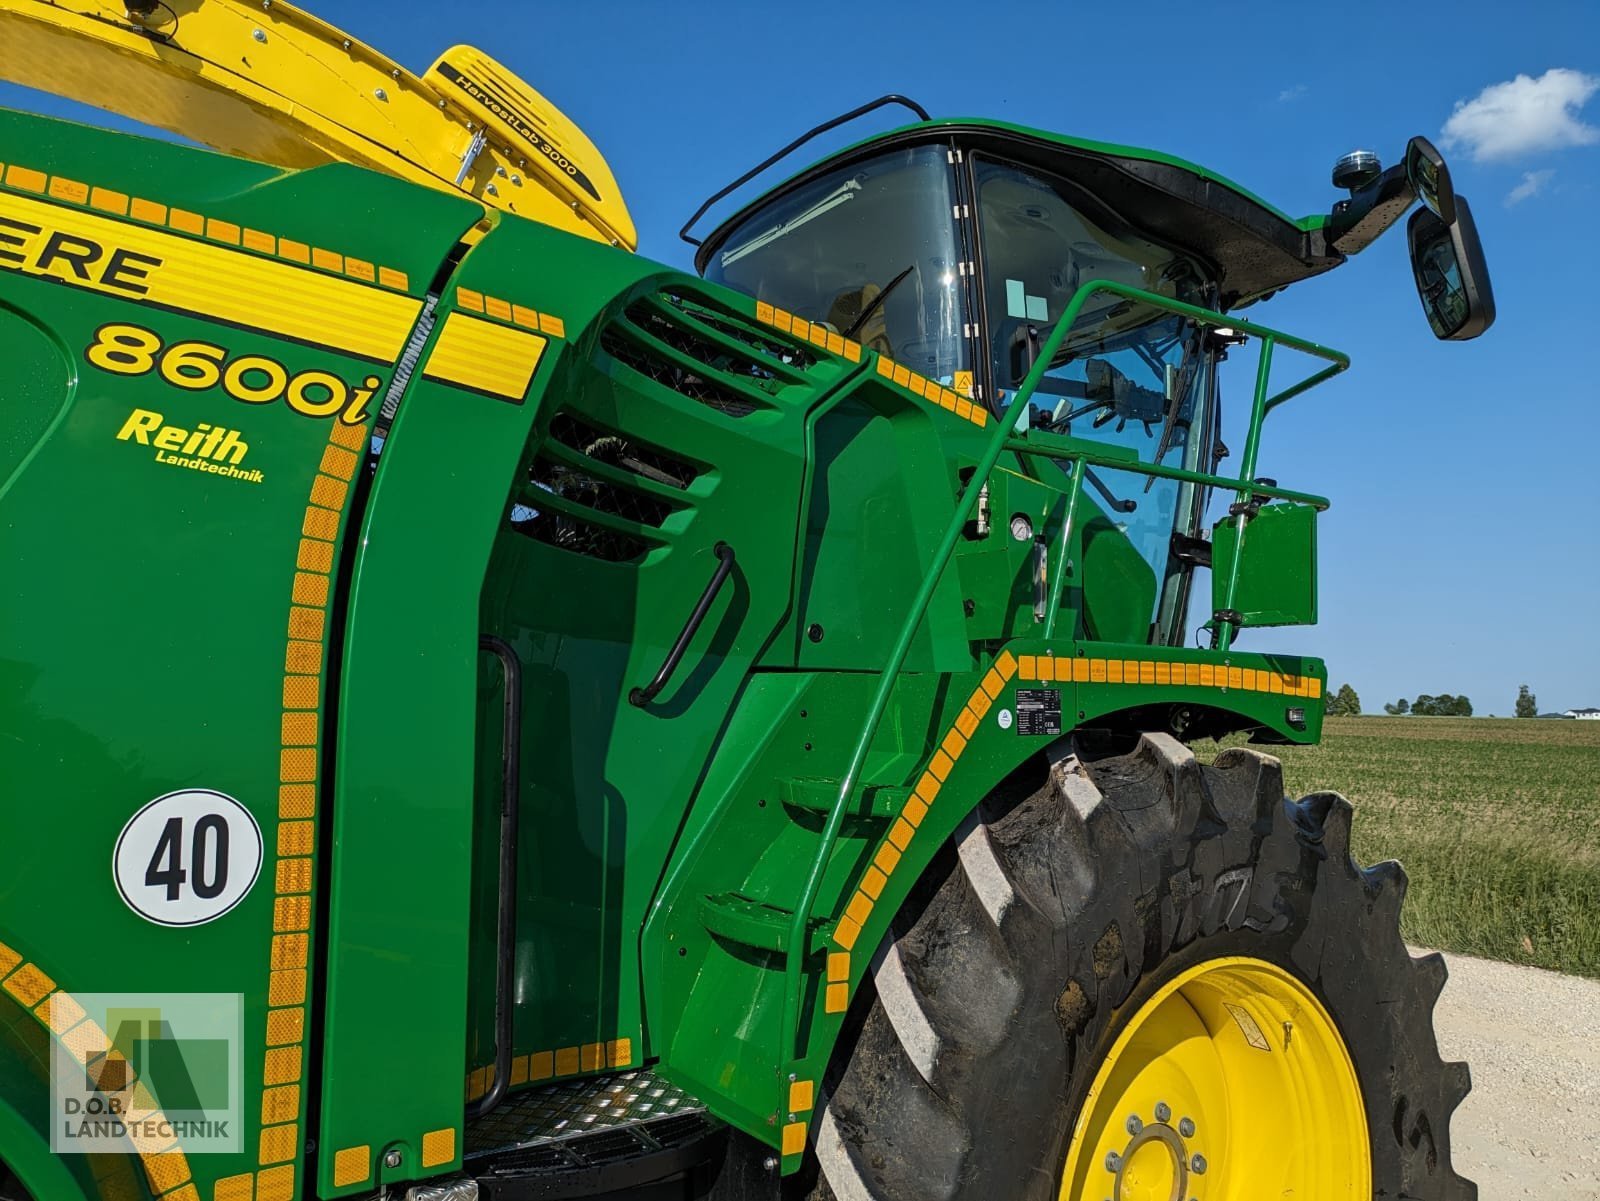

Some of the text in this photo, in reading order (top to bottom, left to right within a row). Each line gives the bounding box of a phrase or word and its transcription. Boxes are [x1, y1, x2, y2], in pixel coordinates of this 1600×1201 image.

[455, 76, 577, 176] HarvestLab 3000
[85, 322, 383, 425] 8600i
[116, 408, 249, 465] Reith
[155, 450, 264, 483] Landtechnik
[145, 813, 229, 901] 40
